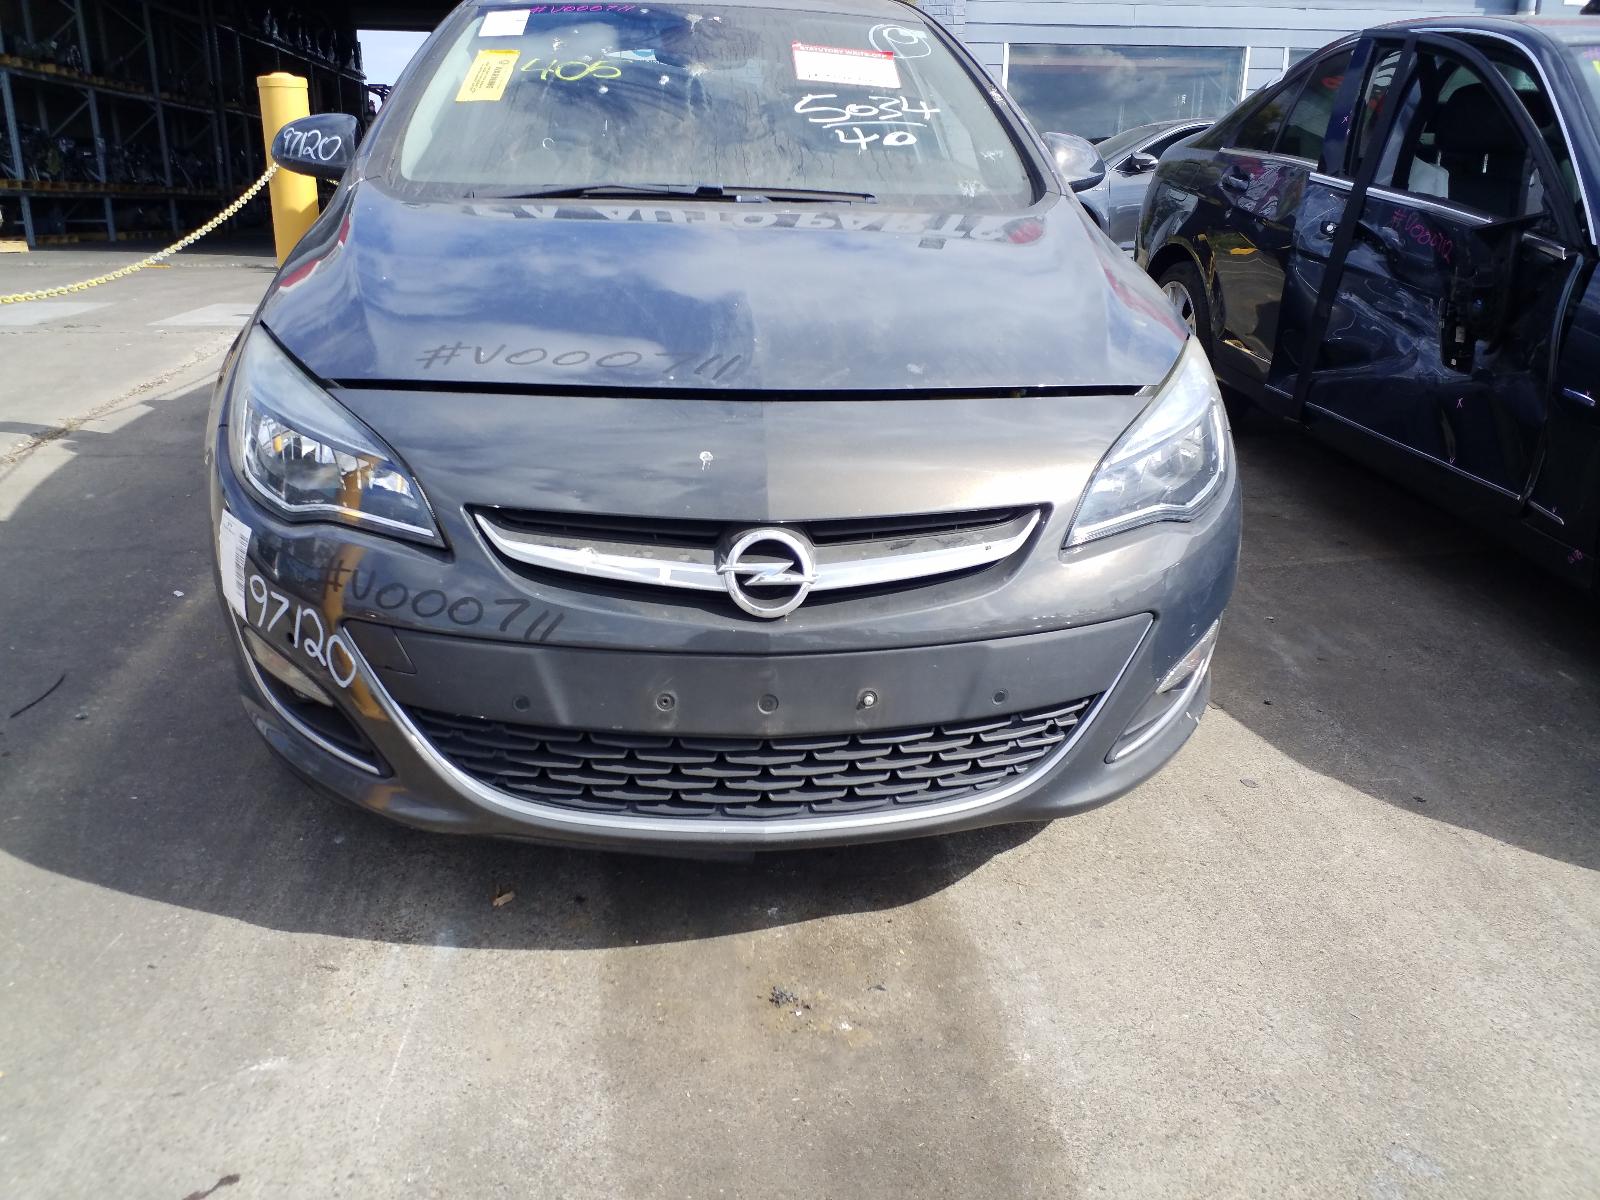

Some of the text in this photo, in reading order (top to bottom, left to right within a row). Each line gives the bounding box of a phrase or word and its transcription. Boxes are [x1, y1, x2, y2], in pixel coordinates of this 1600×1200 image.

[800, 44, 843, 54] STATUTORY
[520, 58, 632, 80] 405
[794, 93, 940, 123] 5034
[283, 127, 342, 160] 97120
[835, 126, 917, 150] 40
[415, 341, 741, 380] #V000711
[325, 559, 565, 642] #V000711
[249, 574, 357, 688] 97120
